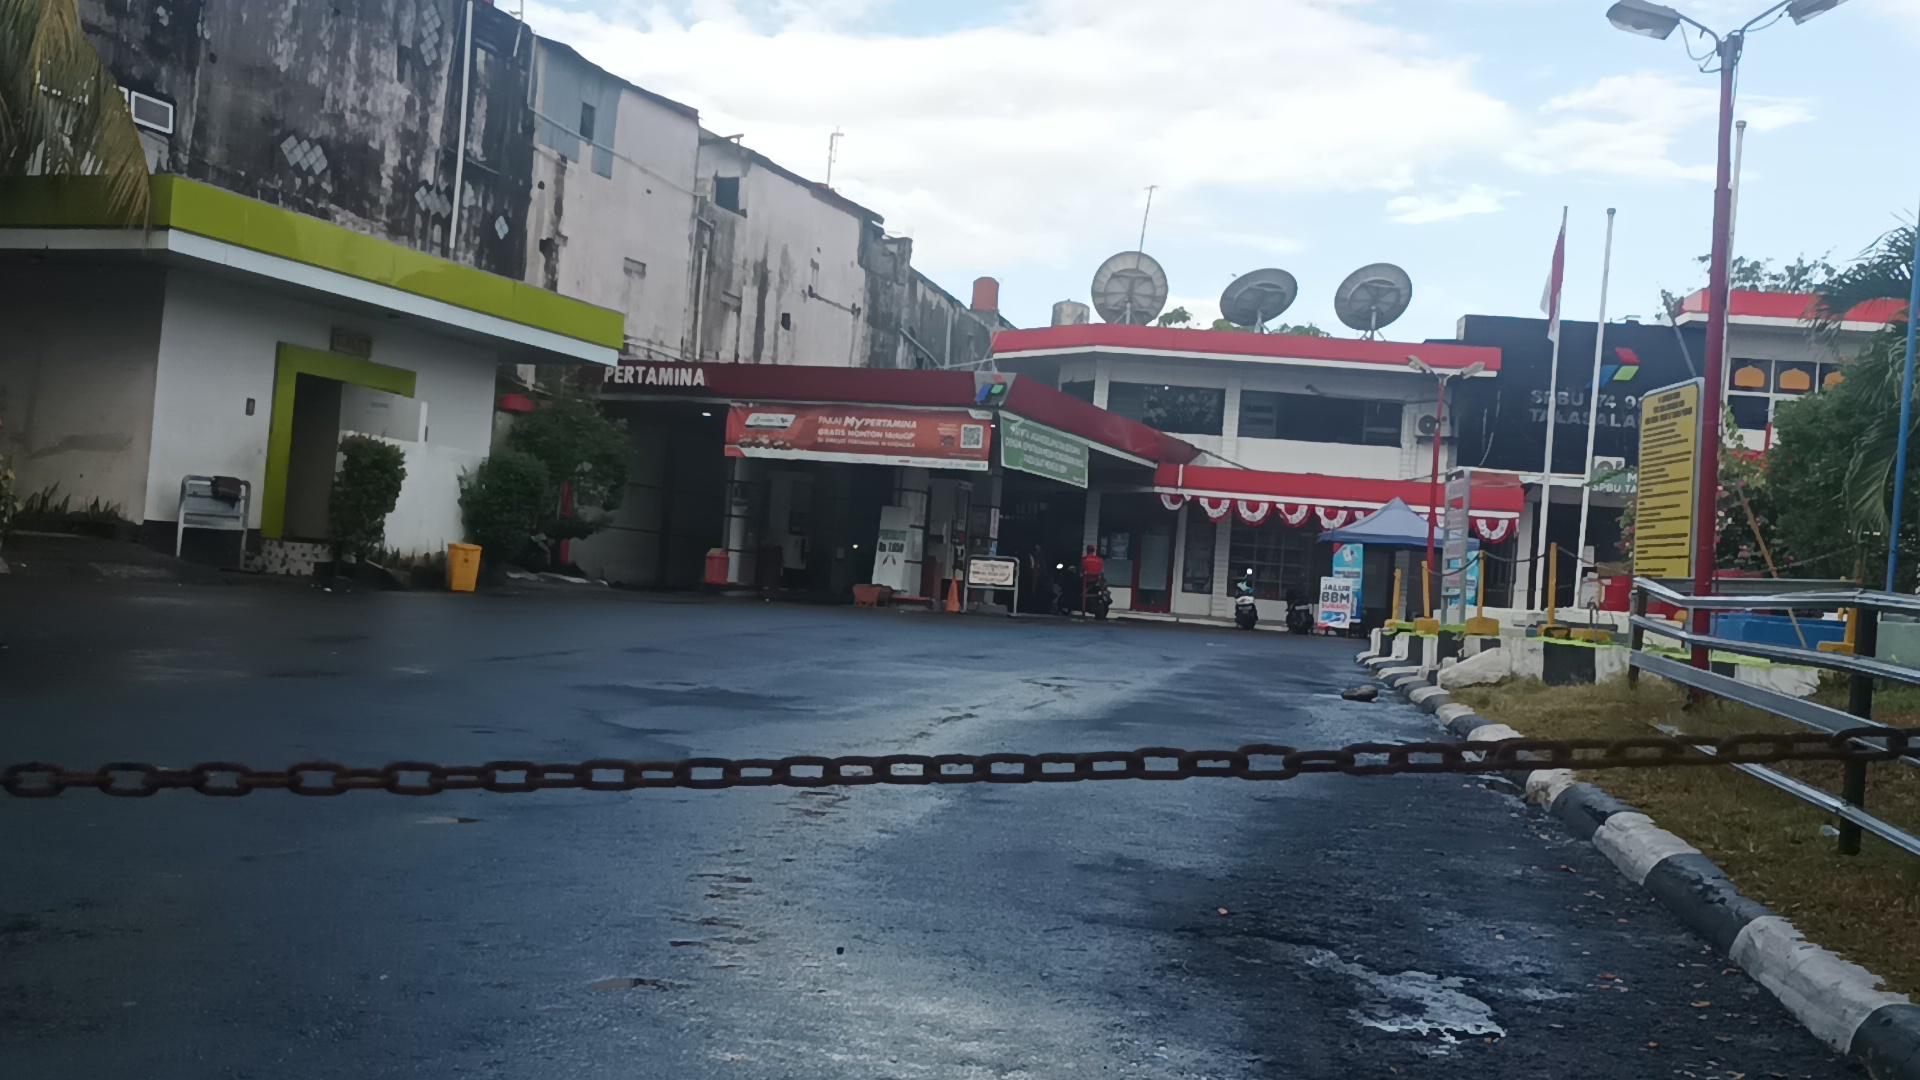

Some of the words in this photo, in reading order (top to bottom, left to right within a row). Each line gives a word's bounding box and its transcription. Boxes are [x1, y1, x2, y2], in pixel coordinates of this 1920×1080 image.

[603, 365, 706, 387] PERTAMINA
[1592, 482, 1622, 494] SPBU
[1323, 584, 1351, 592] JALUR
[1321, 592, 1350, 603] BBM
